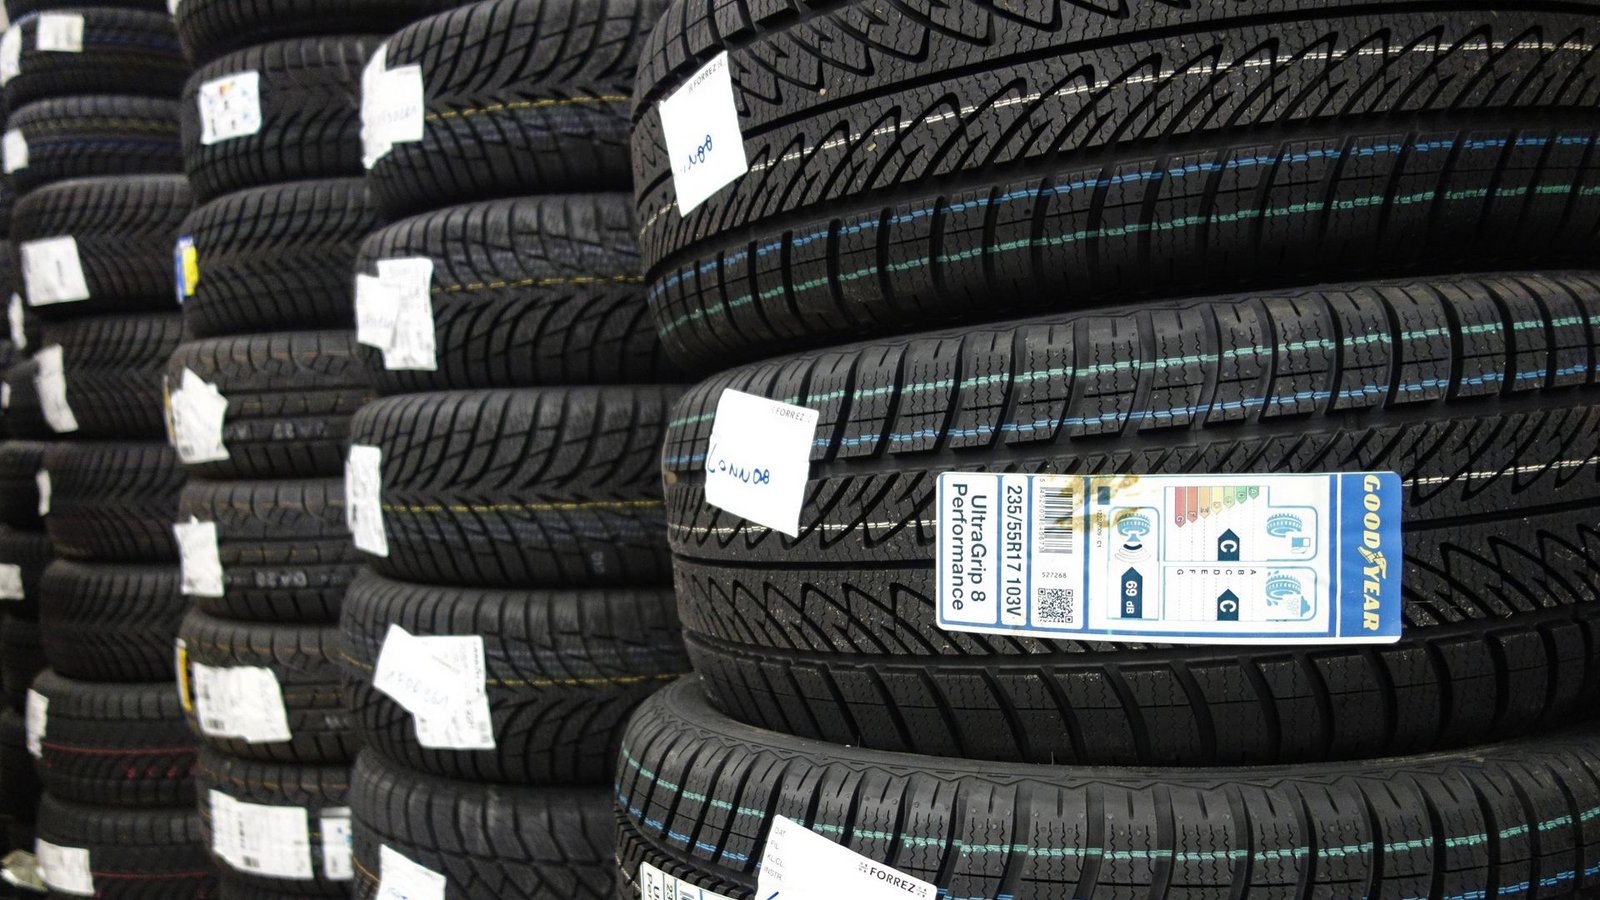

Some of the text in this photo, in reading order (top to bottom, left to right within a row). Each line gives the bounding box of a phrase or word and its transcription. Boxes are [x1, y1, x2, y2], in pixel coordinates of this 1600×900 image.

[692, 65, 718, 90] FORREZ
[775, 408, 805, 421] FORREZ
[952, 483, 968, 611] Performance
[967, 494, 987, 602] UltraGrip 8
[1006, 485, 1023, 616] 235/55R17 103V
[1220, 539, 1238, 553] C
[1363, 474, 1381, 631] GOODYEAR
[1041, 571, 1067, 579] 527268
[1125, 580, 1138, 614] 69 dB
[1219, 600, 1237, 613] C
[869, 867, 916, 893] FORREZ
